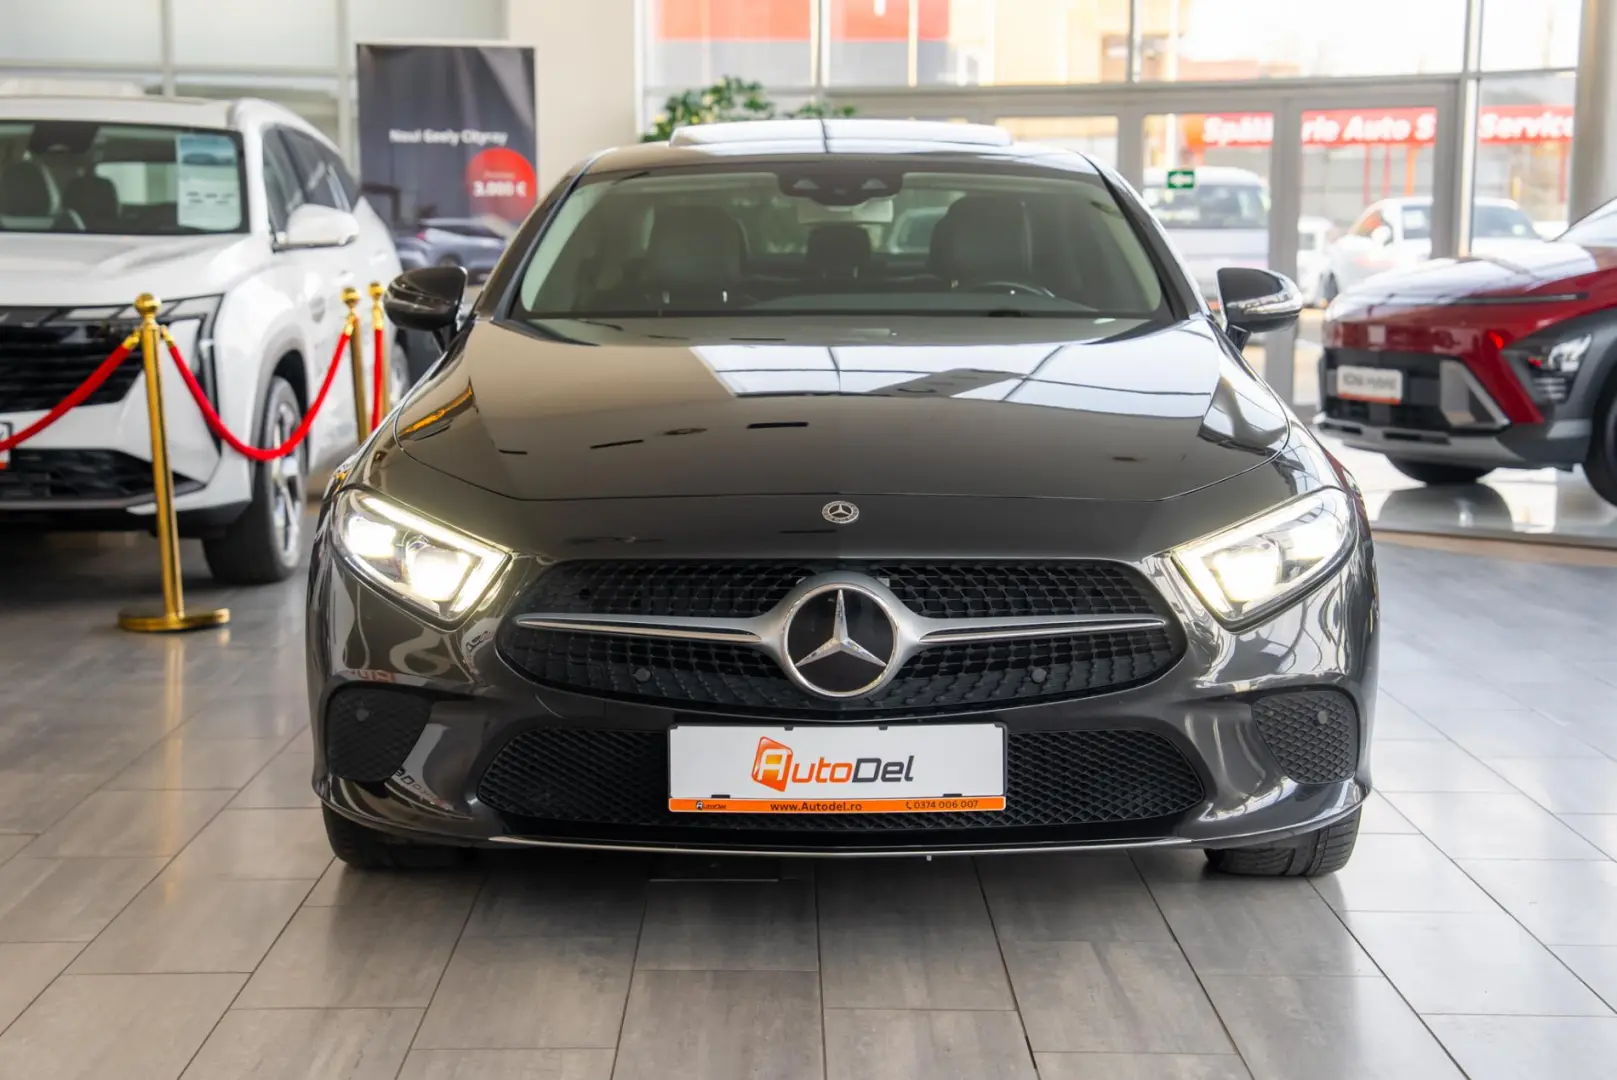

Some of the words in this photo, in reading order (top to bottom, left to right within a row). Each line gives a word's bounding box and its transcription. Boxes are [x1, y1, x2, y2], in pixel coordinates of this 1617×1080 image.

[1342, 115, 1411, 142] Auto
[423, 129, 460, 146] Geely
[755, 746, 914, 785] AutoDel
[770, 801, 862, 811] www.Autodel.ro
[914, 800, 936, 809] 0374
[939, 799, 958, 809] 006
[960, 799, 979, 808] 007
